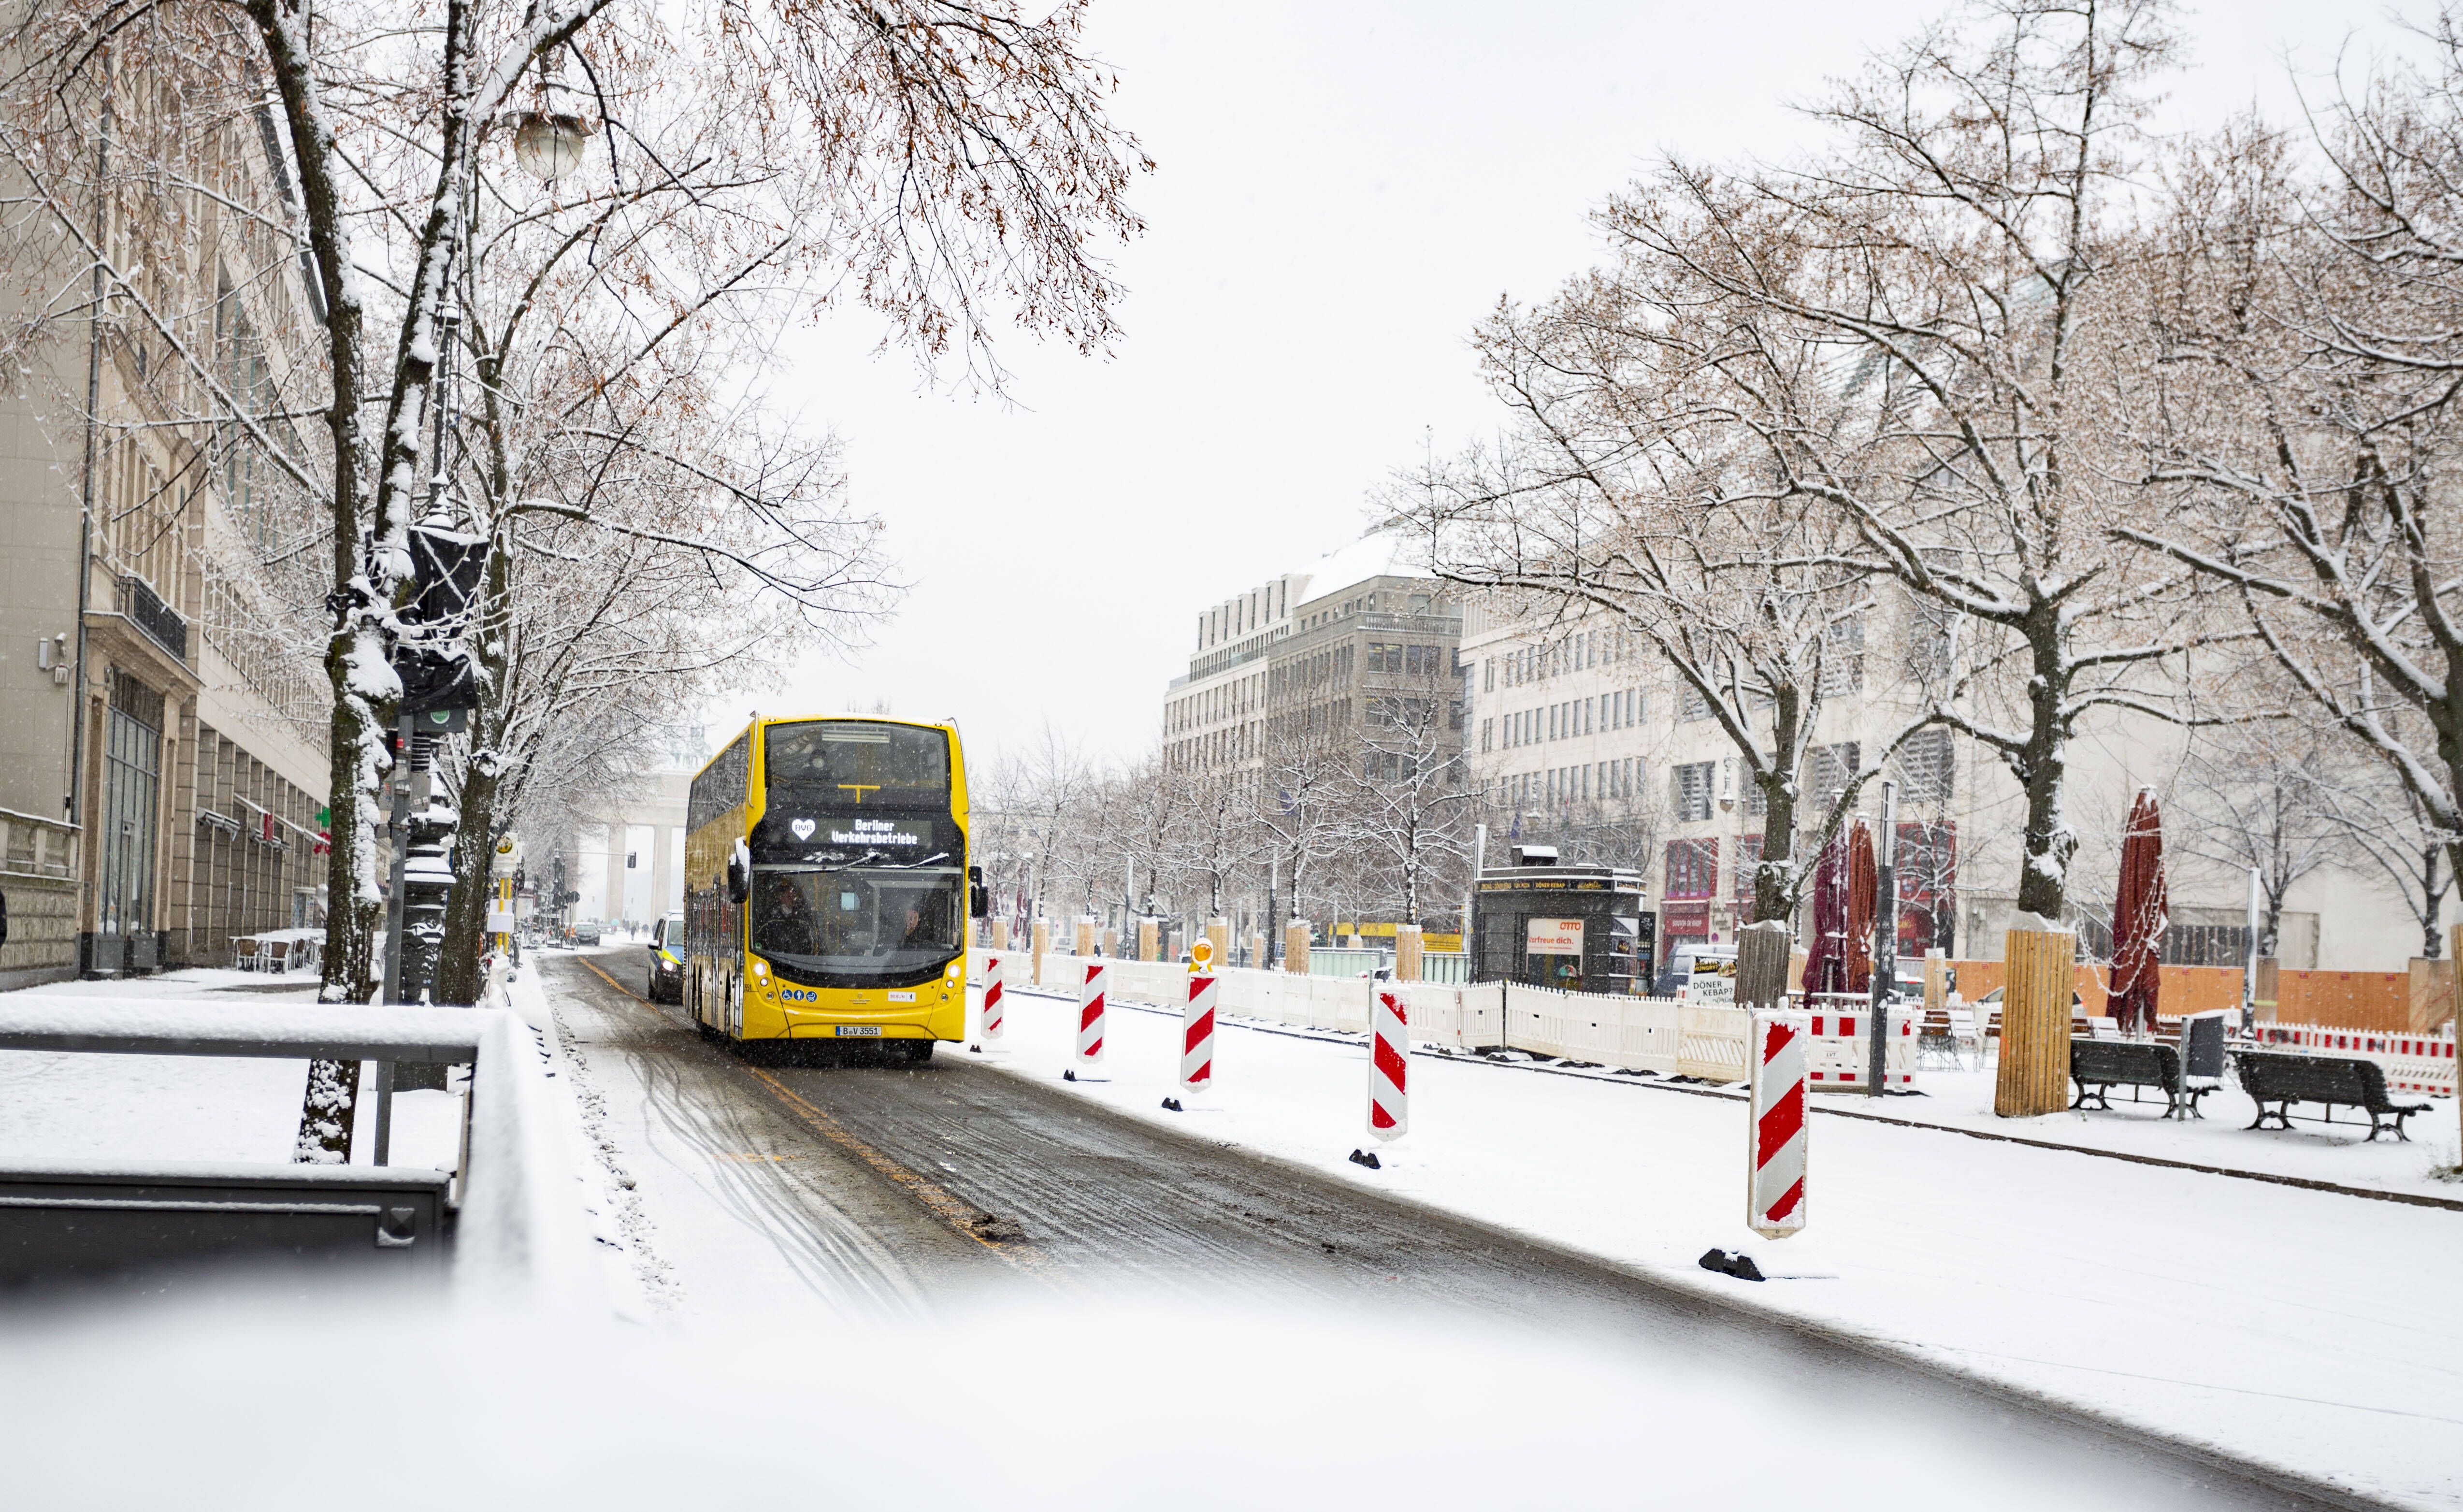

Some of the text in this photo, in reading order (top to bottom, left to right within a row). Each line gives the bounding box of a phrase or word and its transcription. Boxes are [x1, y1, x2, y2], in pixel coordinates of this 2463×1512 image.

[855, 819, 894, 831] Berliner
[832, 831, 918, 845] Verkehrsbetriebe
[1560, 922, 1582, 931] OTTO
[1556, 936, 1574, 945] dich.
[1693, 980, 1722, 990] DÖNER
[1703, 987, 1733, 997] KEBAP?
